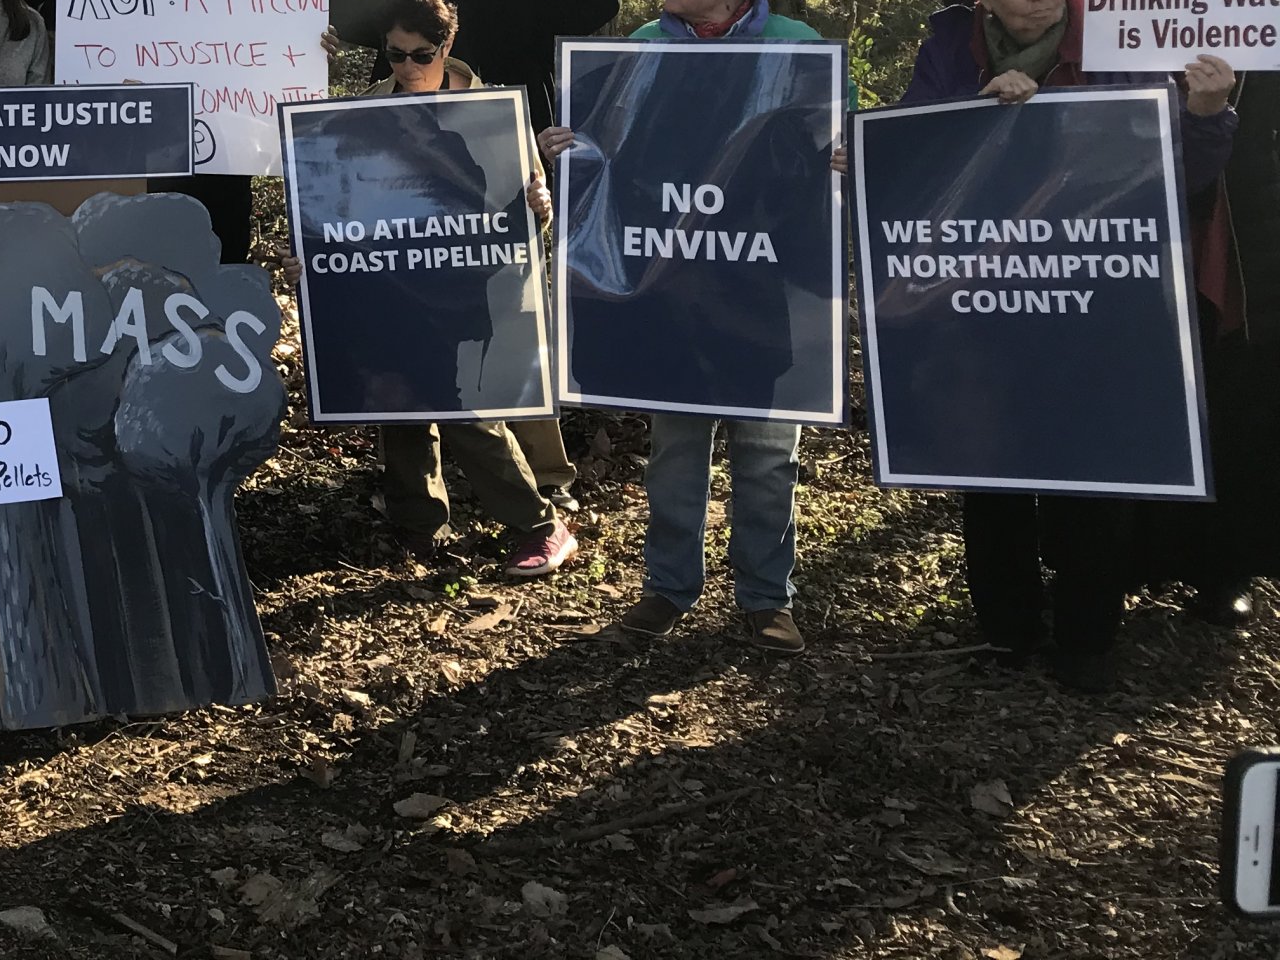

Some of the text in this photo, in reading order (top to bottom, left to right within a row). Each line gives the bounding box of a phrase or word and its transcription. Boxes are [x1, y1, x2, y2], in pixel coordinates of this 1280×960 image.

[1118, 18, 1277, 49] is Violence
[74, 44, 116, 69] TO
[136, 42, 268, 68] INJUSTICE
[41, 101, 152, 132] JUSTICE
[662, 182, 725, 215] NO
[323, 212, 509, 243] NO ATLANTIC
[881, 218, 1158, 244] WE STAND WITH
[312, 242, 528, 274] COAST PIPELINE
[624, 226, 778, 263] ENVIVA
[887, 254, 1160, 278] NORTHAMPTON
[951, 289, 1094, 314] COUNTY
[31, 286, 266, 394] MASS
